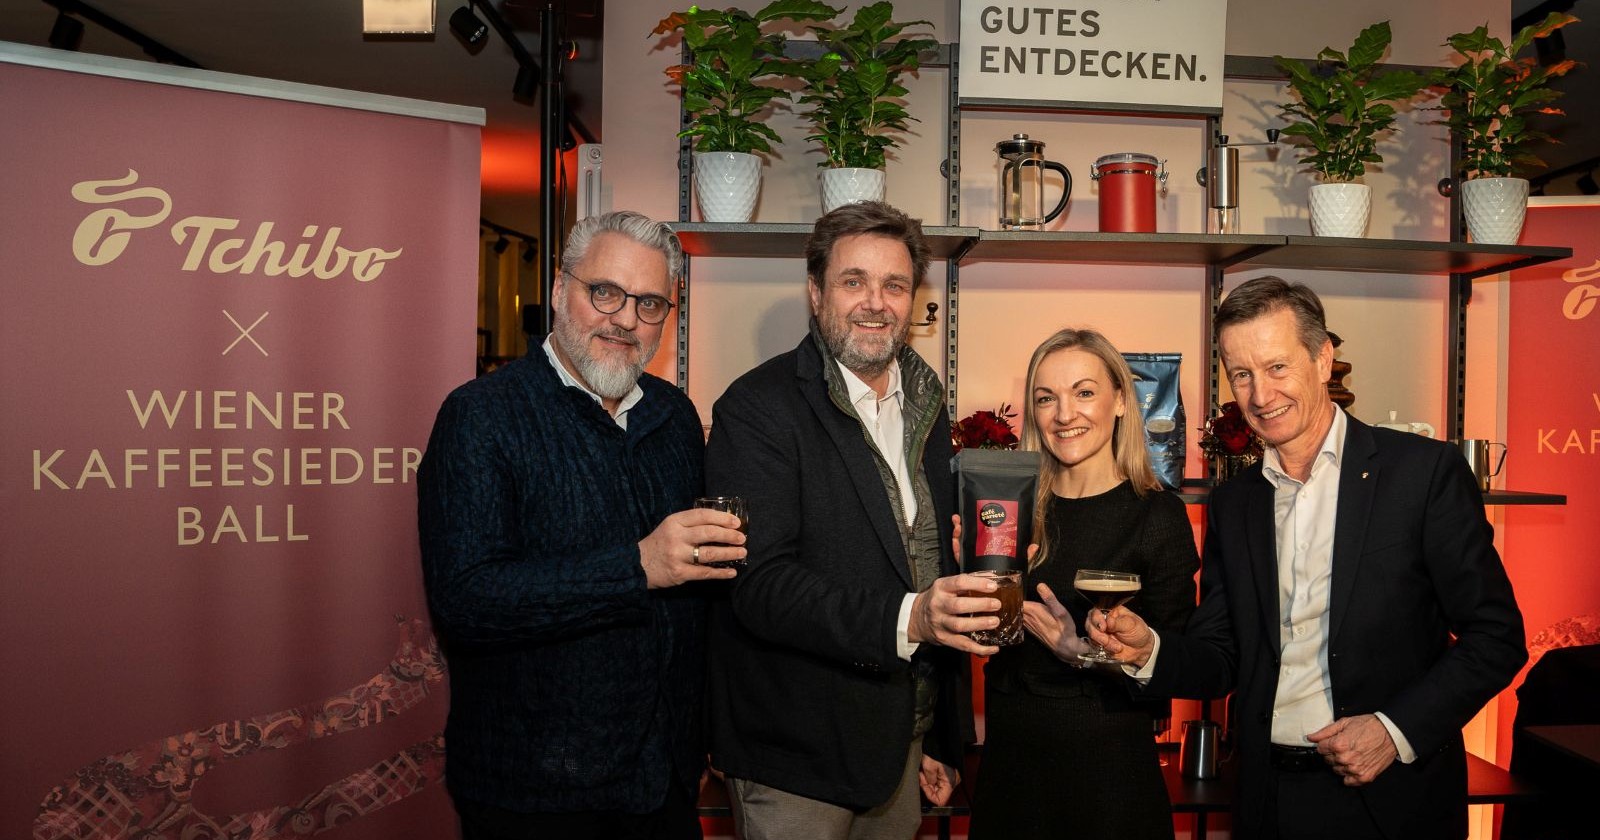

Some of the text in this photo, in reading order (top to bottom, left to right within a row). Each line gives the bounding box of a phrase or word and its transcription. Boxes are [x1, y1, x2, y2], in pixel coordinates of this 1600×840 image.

[980, 6, 1100, 37] GUTES
[980, 46, 1207, 82] ENTDECKEN.
[171, 216, 402, 282] Tchibo
[126, 389, 350, 430] WIENER
[32, 447, 422, 490] KAFFEESIEDER
[177, 504, 309, 545] BALL
